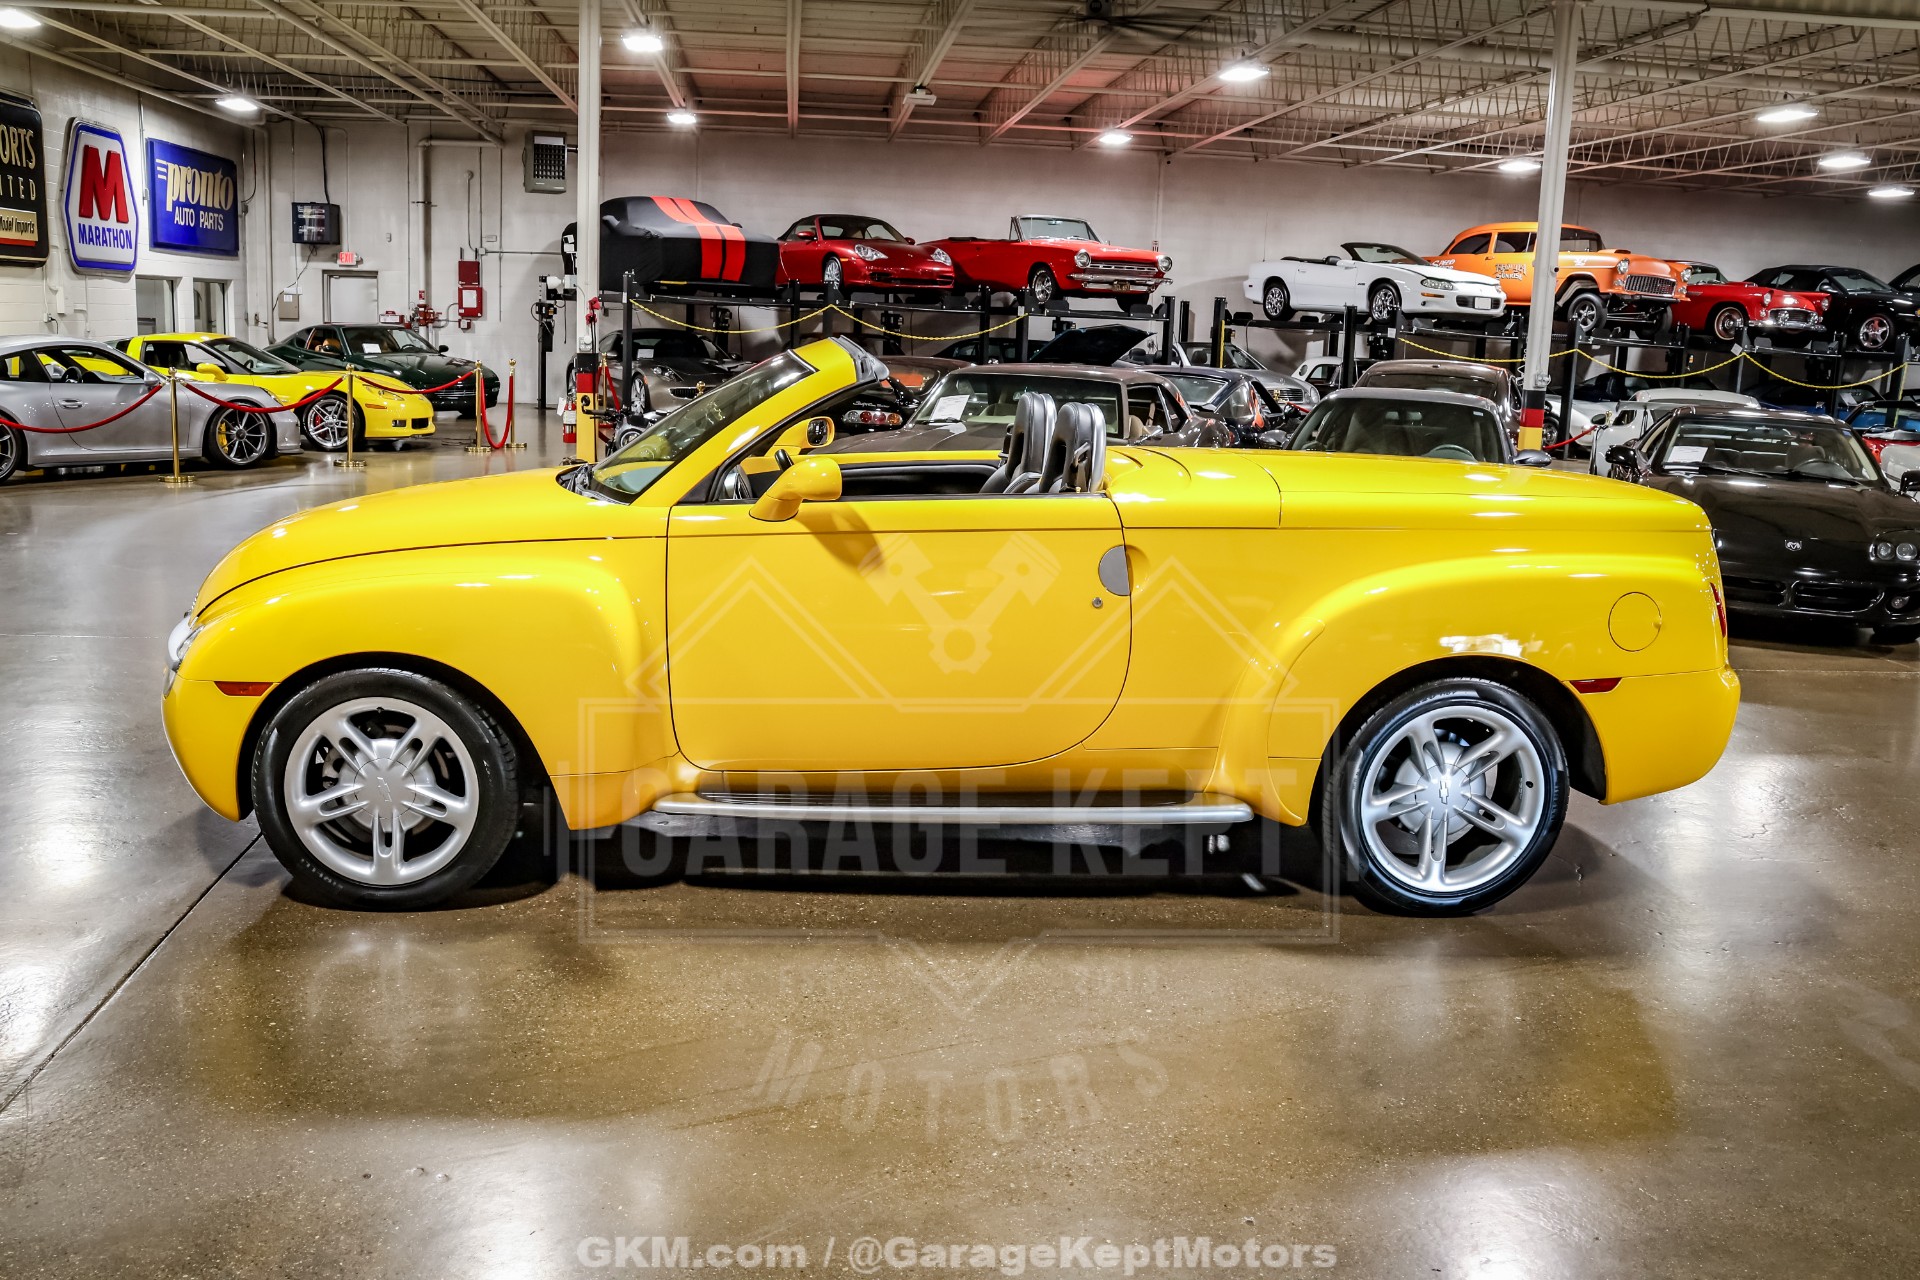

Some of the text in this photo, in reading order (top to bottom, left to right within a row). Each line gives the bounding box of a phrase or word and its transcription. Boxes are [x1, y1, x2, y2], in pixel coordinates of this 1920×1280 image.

[165, 161, 234, 212] pronto
[174, 206, 224, 232] AUTO PARTS
[78, 222, 133, 250] MARATHON
